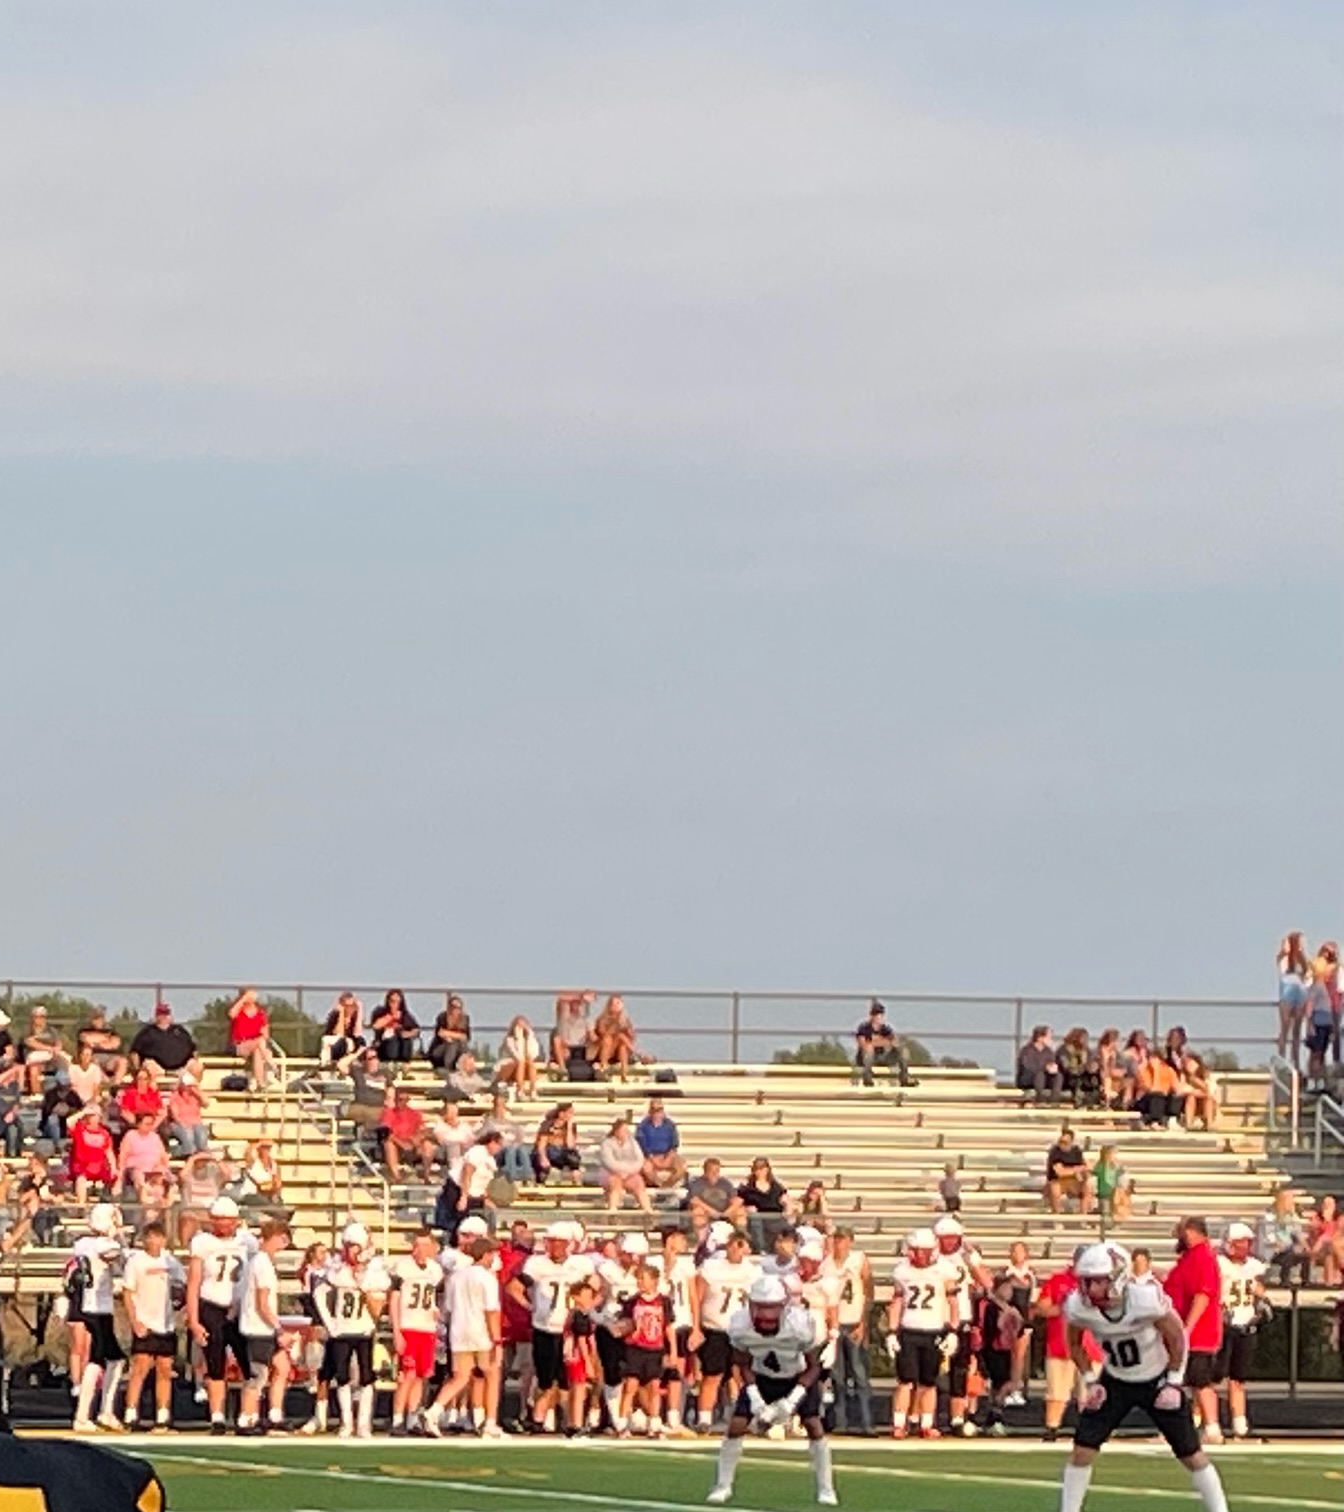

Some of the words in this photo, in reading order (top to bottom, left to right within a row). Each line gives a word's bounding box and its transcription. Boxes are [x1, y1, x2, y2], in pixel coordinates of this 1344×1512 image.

[907, 1283, 935, 1309] 22
[764, 1350, 782, 1374] 4
[1102, 1338, 1141, 1367] 10
